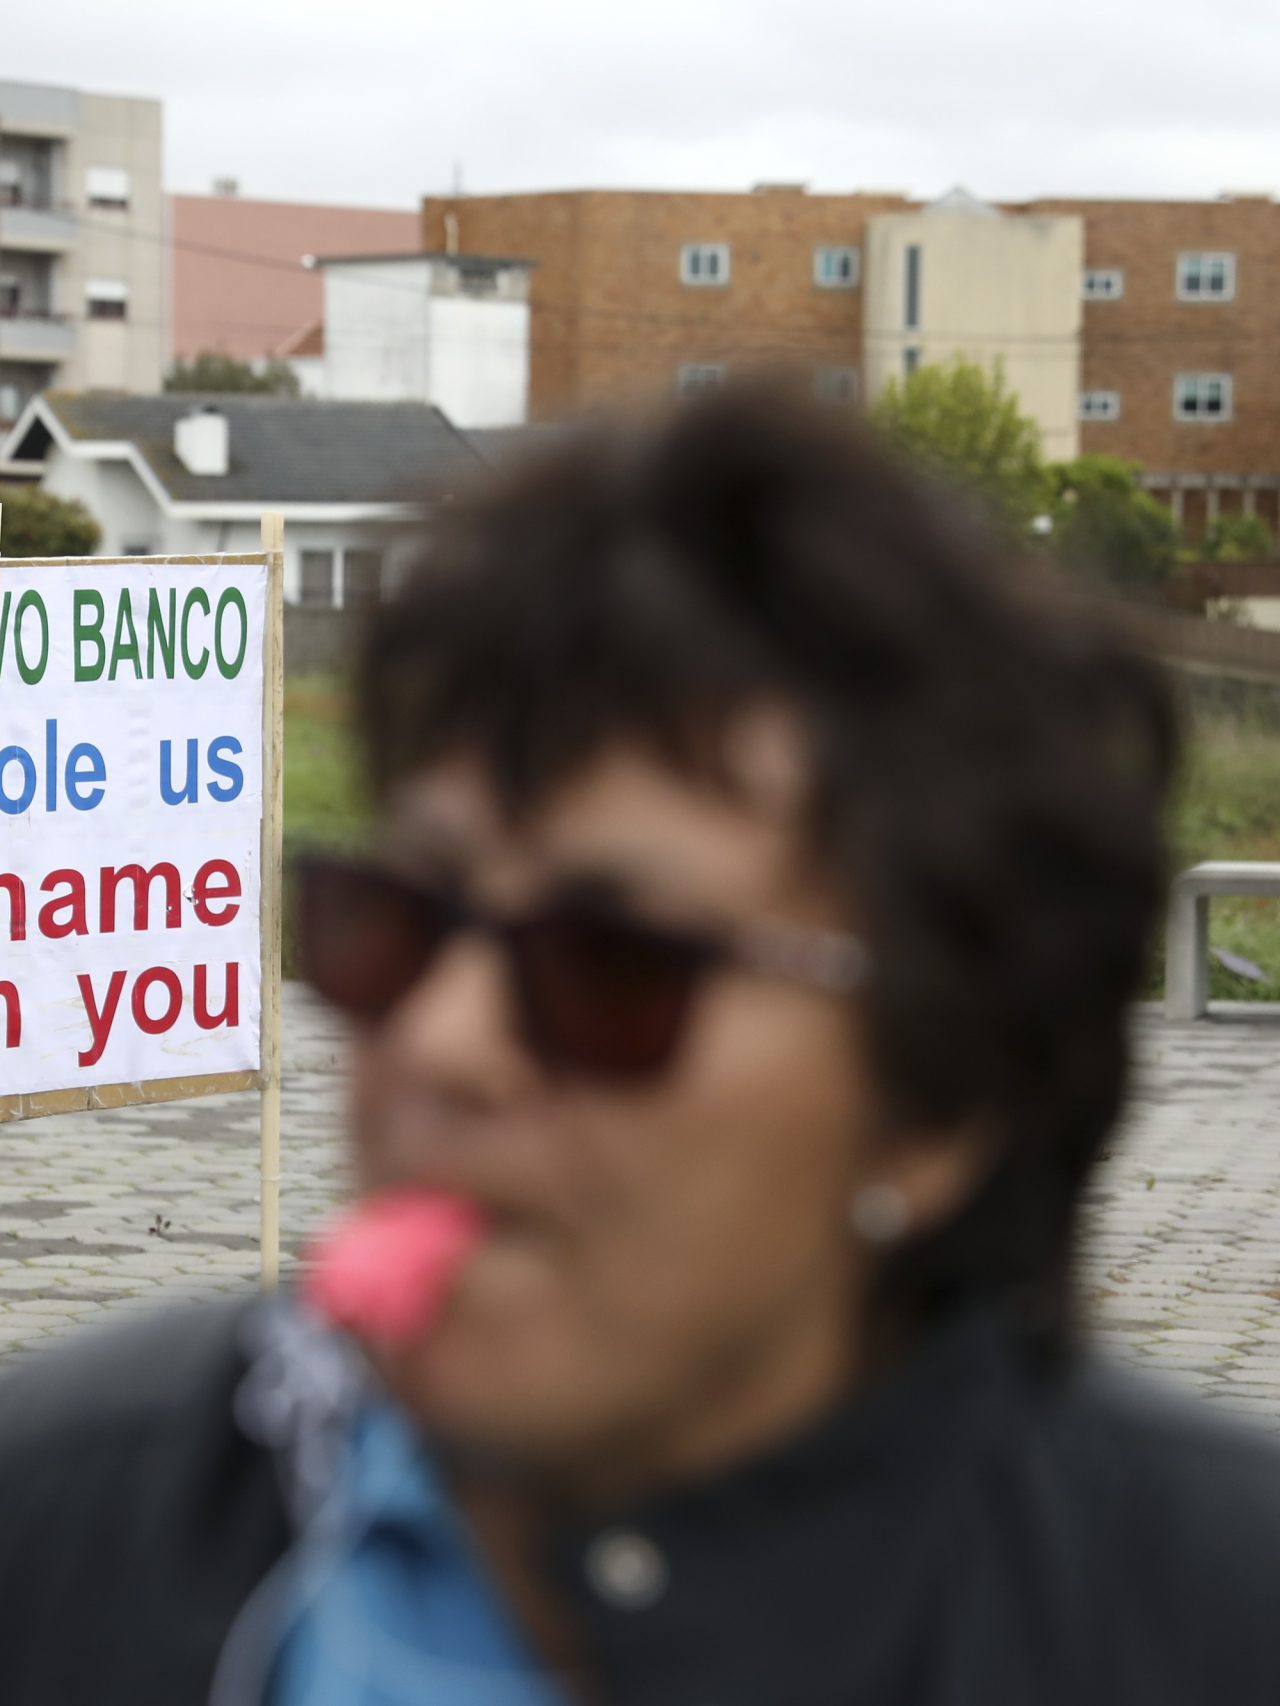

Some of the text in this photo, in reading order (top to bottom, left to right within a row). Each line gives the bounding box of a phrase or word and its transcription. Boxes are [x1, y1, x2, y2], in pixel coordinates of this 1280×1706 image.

[72, 586, 247, 682] BANCO
[160, 735, 244, 805] us
[77, 962, 240, 1067] you
